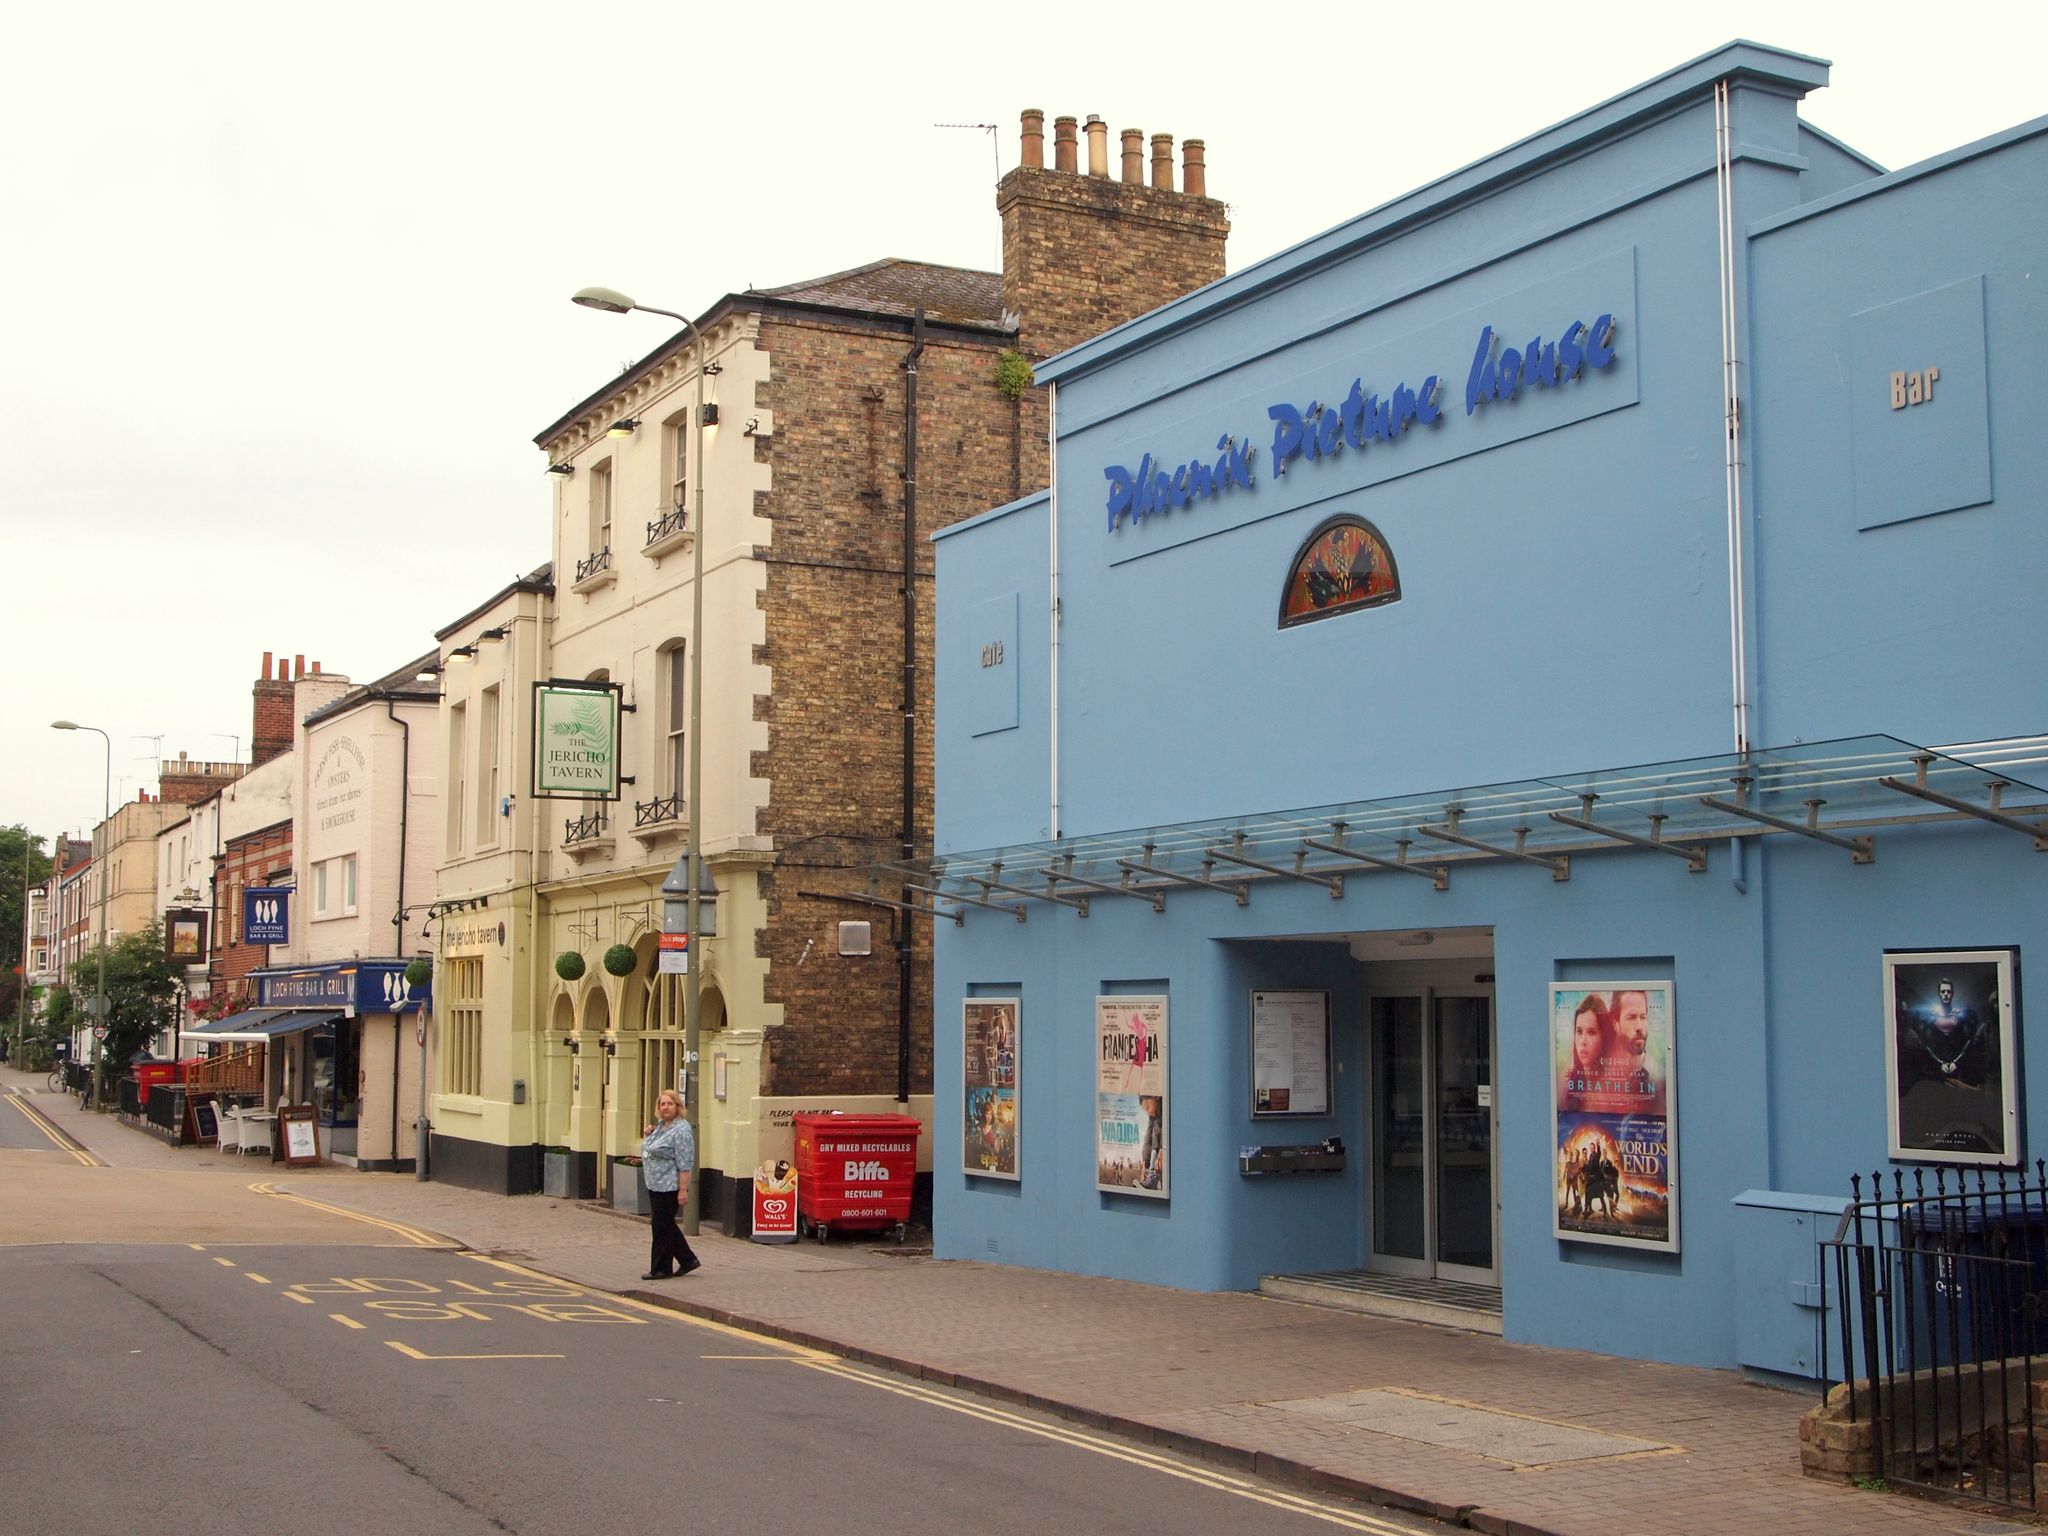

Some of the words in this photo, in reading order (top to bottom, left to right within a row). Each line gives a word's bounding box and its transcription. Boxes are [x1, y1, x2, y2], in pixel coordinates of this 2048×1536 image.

[1890, 367, 1939, 410] Bar
[1104, 433, 1256, 533] Phoenix
[1268, 376, 1444, 480] Picture
[1466, 313, 1617, 417] house
[568, 738, 586, 746] THE
[548, 750, 606, 763] JERICHO
[328, 770, 350, 788] OYSTERS
[550, 766, 603, 778] TAVERN
[446, 926, 455, 947] the
[455, 923, 476, 951] jericho
[477, 924, 497, 944] tavern
[273, 982, 288, 998] LOCH
[289, 981, 304, 997] FYNE
[305, 981, 318, 996] BAR
[319, 981, 324, 996] &
[327, 979, 345, 995] GRILL
[1568, 1080, 1630, 1092] BREATHE
[1640, 1082, 1656, 1093] IN
[820, 1144, 834, 1152] DRY
[837, 1144, 860, 1152] MIXED
[862, 1143, 911, 1152] RECYCLABLES
[1615, 1140, 1667, 1157] WORLD'S
[844, 1161, 889, 1180] Biffa
[1623, 1154, 1659, 1175] END
[844, 1190, 883, 1198] RECYCLING
[289, 1277, 584, 1297] STOP
[363, 1301, 650, 1324] BUS
